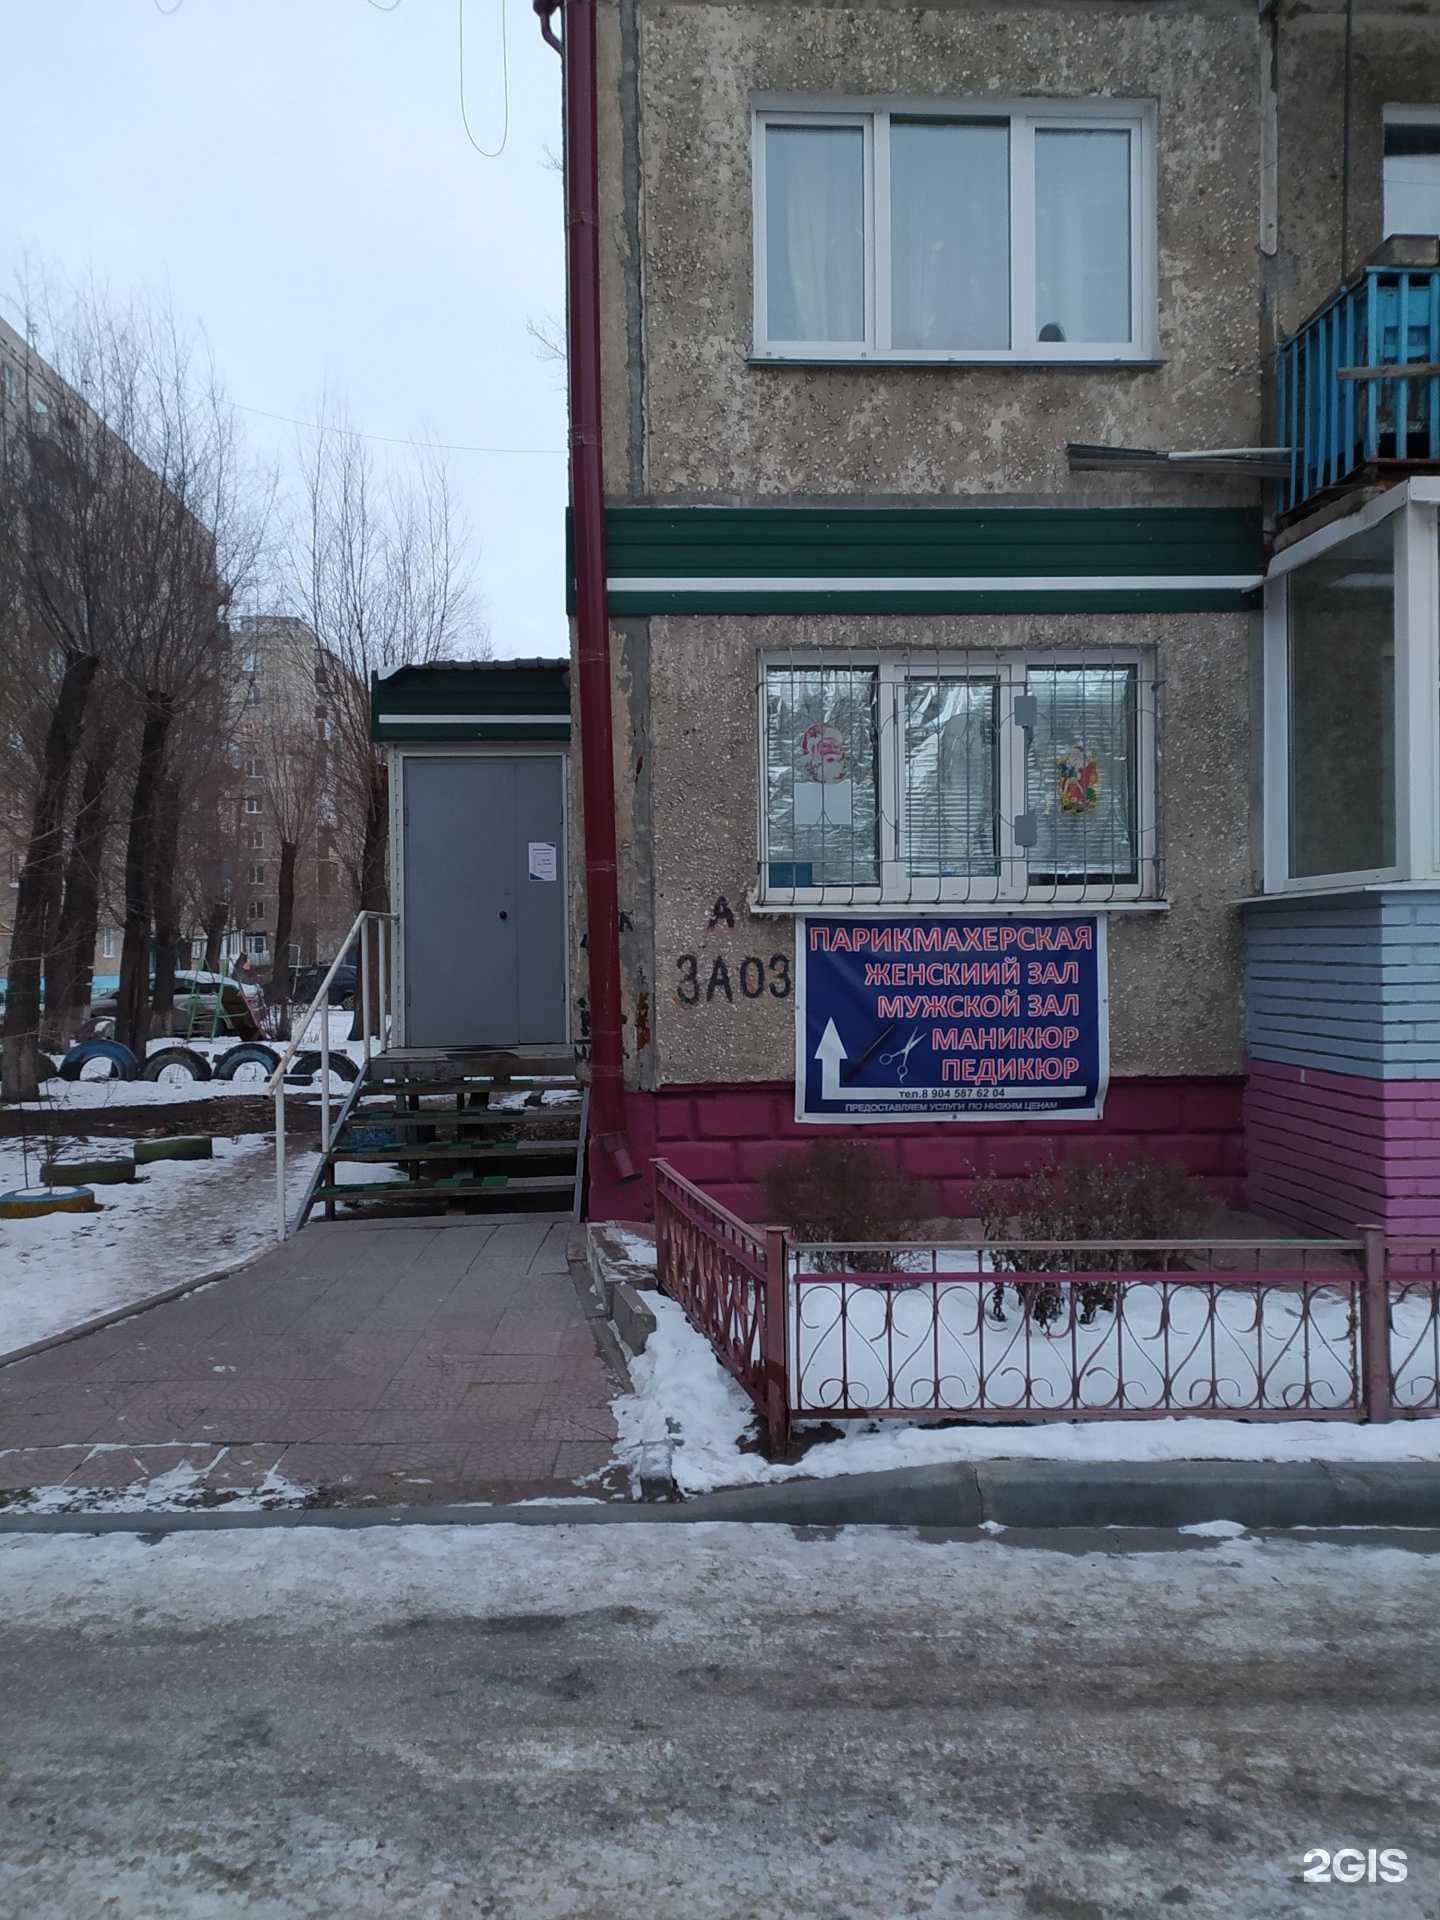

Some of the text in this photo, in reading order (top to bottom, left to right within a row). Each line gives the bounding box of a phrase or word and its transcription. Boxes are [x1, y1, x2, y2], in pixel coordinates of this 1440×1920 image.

[810, 926, 1092, 951] ПАРИКМАХЕРСКАЯ
[864, 957, 1079, 985] ЖЕНСКИИЙ ЗАЛ
[878, 989, 1079, 1018] МУЖСКОЙ ЗАЛ
[932, 1026, 1079, 1050] МАНИКЮР
[942, 1057, 1079, 1085] ПЕДИКЮР
[931, 1089, 951, 1098] 904
[954, 1088, 973, 1098] 587
[976, 1088, 990, 1098] 62
[992, 1088, 1006, 1097] 04
[845, 1103, 928, 1113] ПРЕДОСТАВЛЯЕМ
[929, 1103, 966, 1112] УСЛУГИ
[967, 1103, 982, 1112] ПО
[1024, 1101, 1058, 1111] ЦЕНАМ
